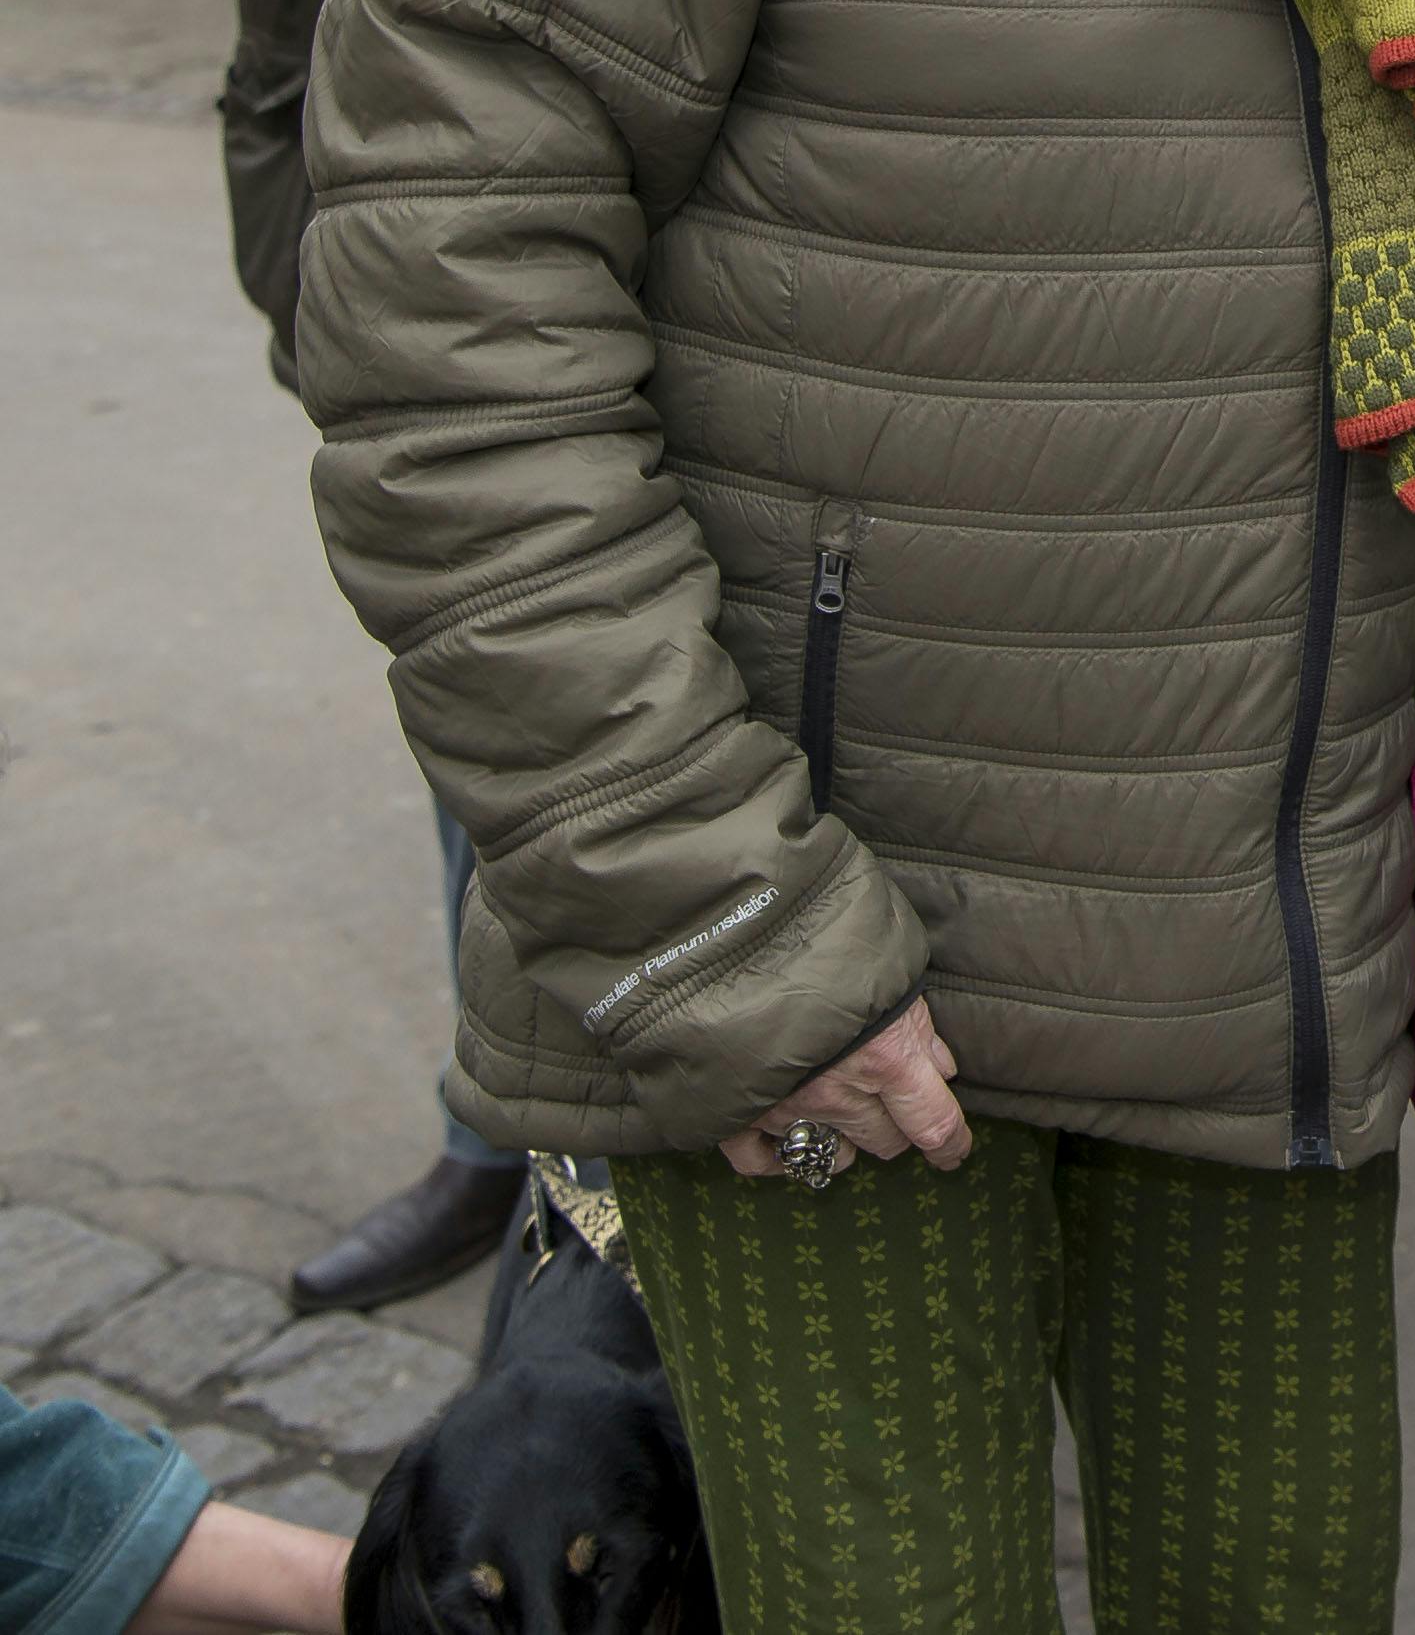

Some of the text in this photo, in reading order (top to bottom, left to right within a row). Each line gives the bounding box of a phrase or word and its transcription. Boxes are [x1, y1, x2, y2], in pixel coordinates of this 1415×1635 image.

[585, 972, 641, 1024] Thinsulate
[644, 931, 709, 977] Platinum
[711, 886, 780, 938] Insulation
